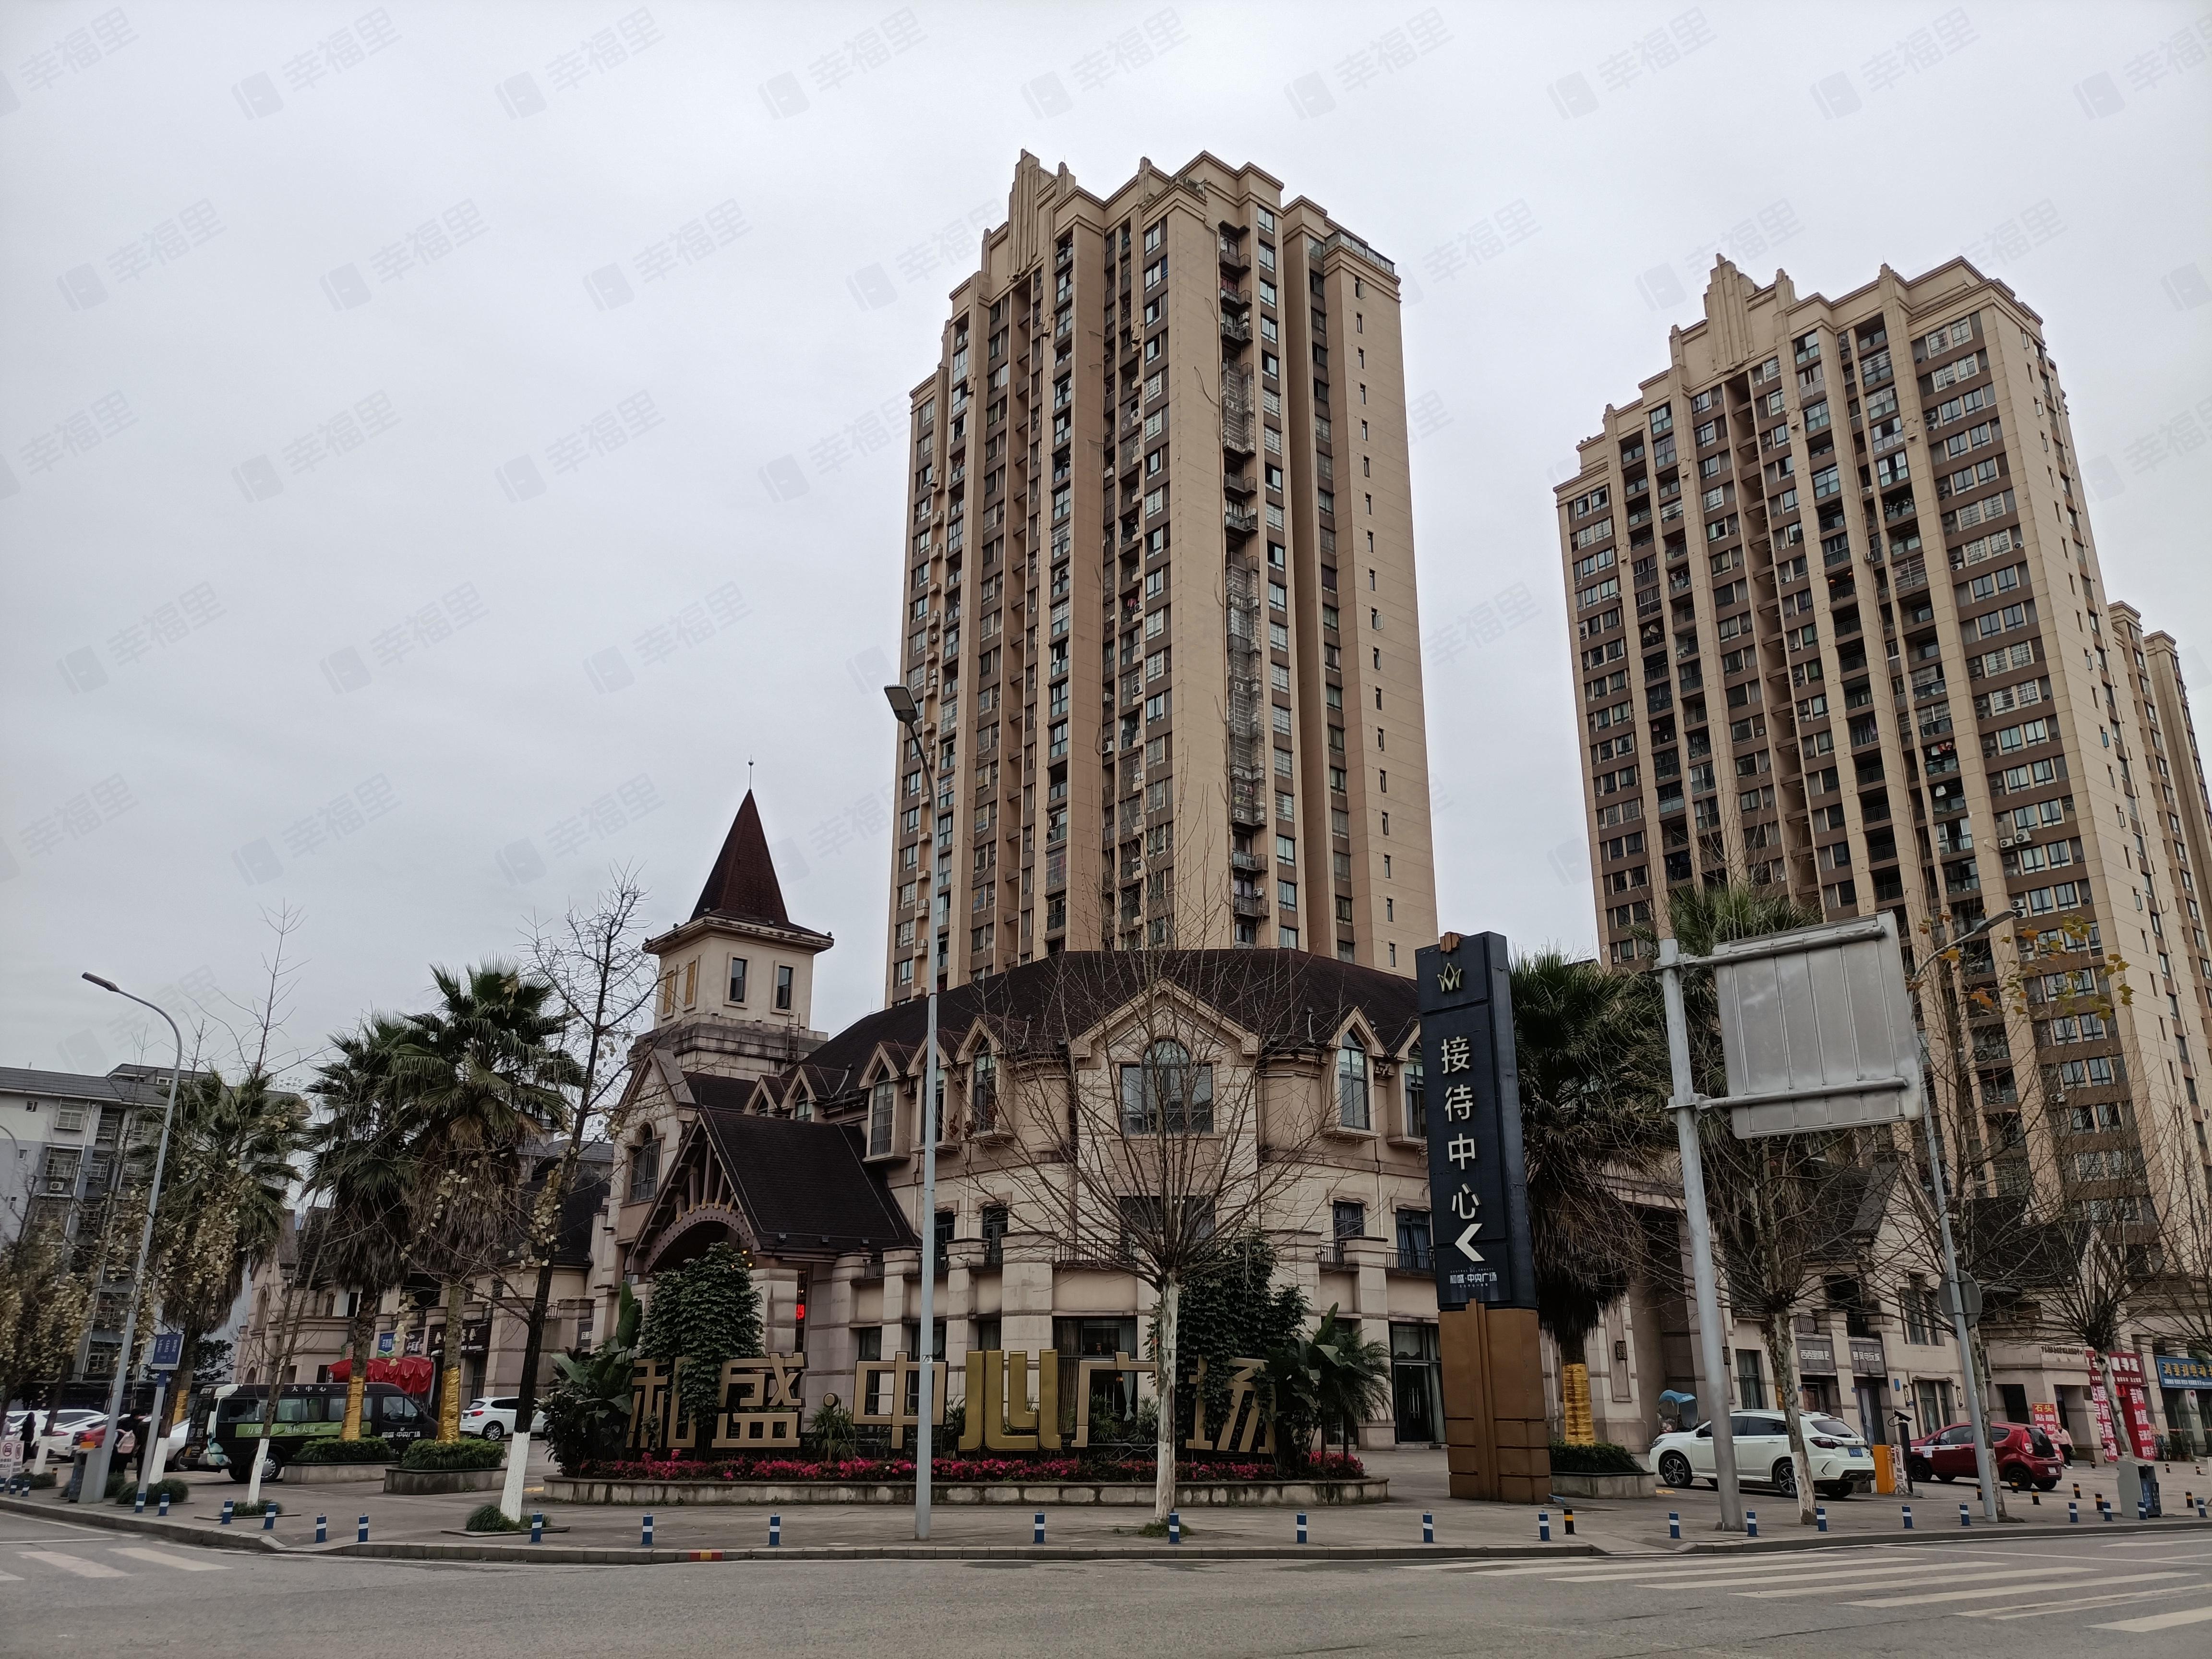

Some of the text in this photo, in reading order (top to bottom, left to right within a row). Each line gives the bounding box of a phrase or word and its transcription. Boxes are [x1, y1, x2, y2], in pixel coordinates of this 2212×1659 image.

[1441, 1036, 1482, 1220] 接待中心
[2129, 1388, 2145, 1405] 音响
[2034, 1404, 2054, 1413] 石头
[2034, 1414, 2056, 1422] 贴膜
[284, 1424, 316, 1434] 地标大盘
[2037, 1423, 2057, 1431] 导航
